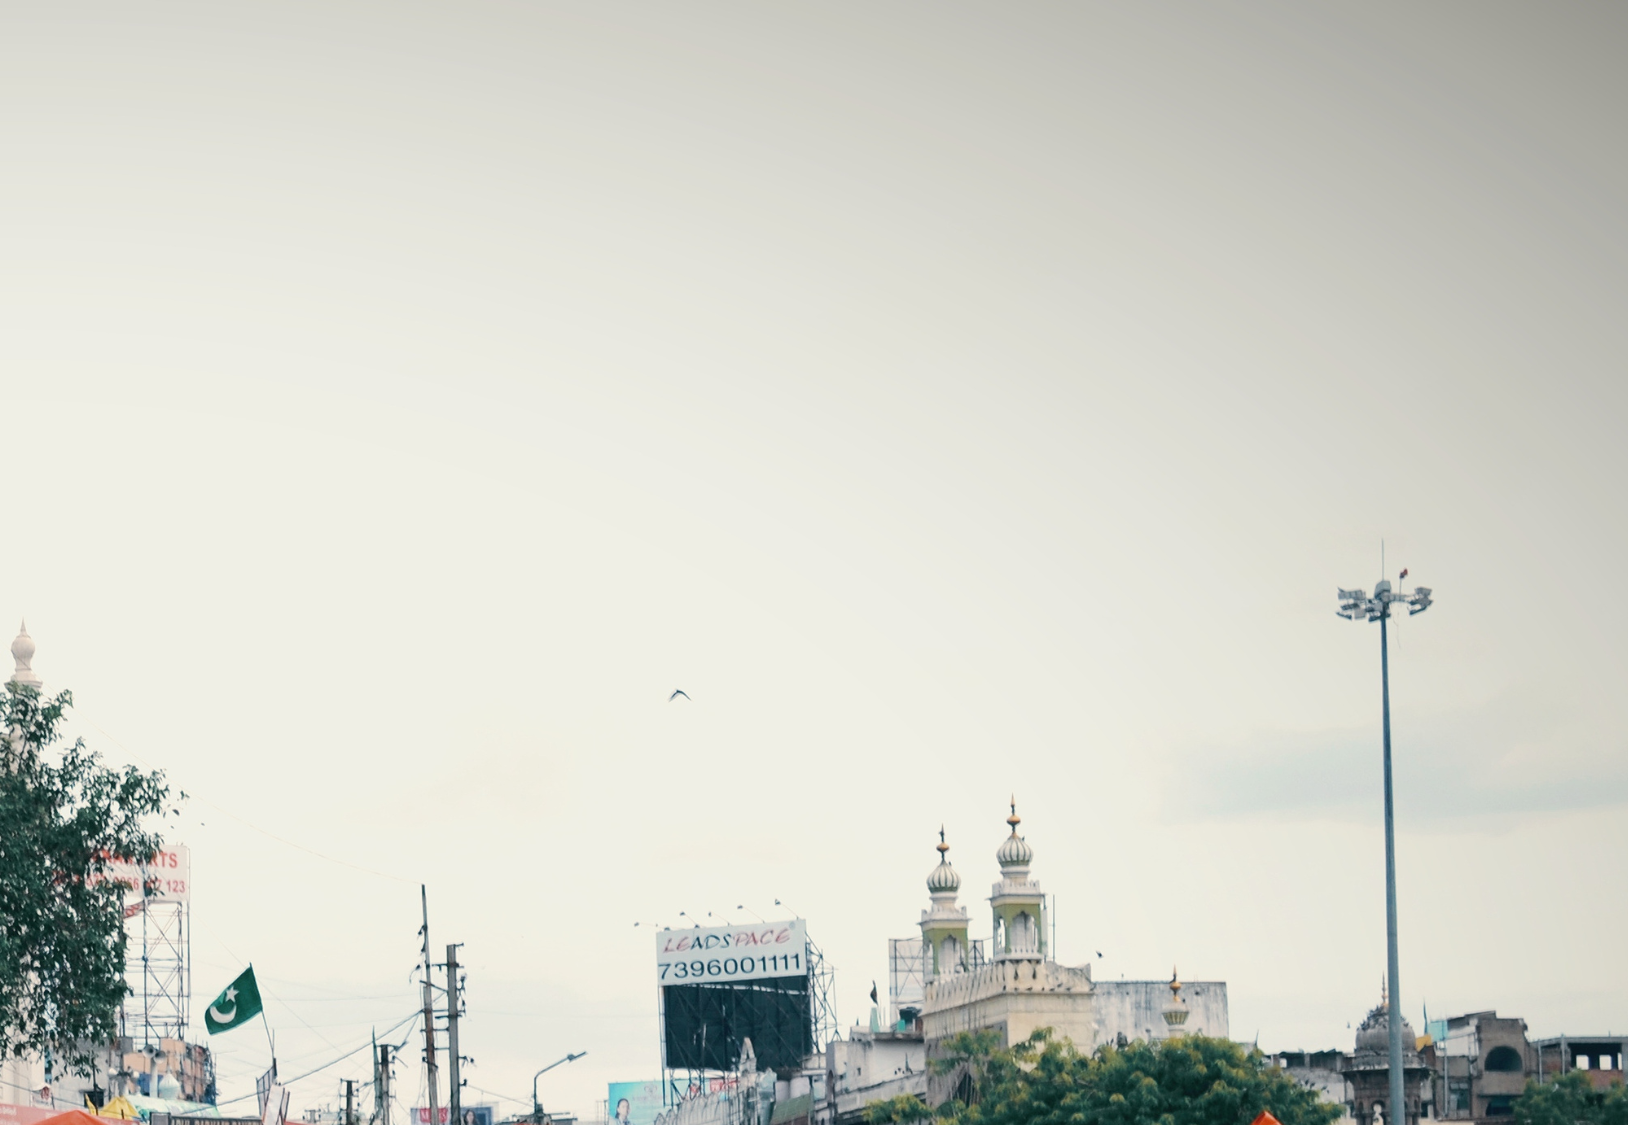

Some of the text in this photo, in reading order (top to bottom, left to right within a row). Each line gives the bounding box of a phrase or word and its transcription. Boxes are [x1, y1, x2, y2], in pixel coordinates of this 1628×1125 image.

[167, 880, 186, 893] 123
[663, 928, 791, 954] LEADSPACE
[658, 953, 800, 980] 7396001111
